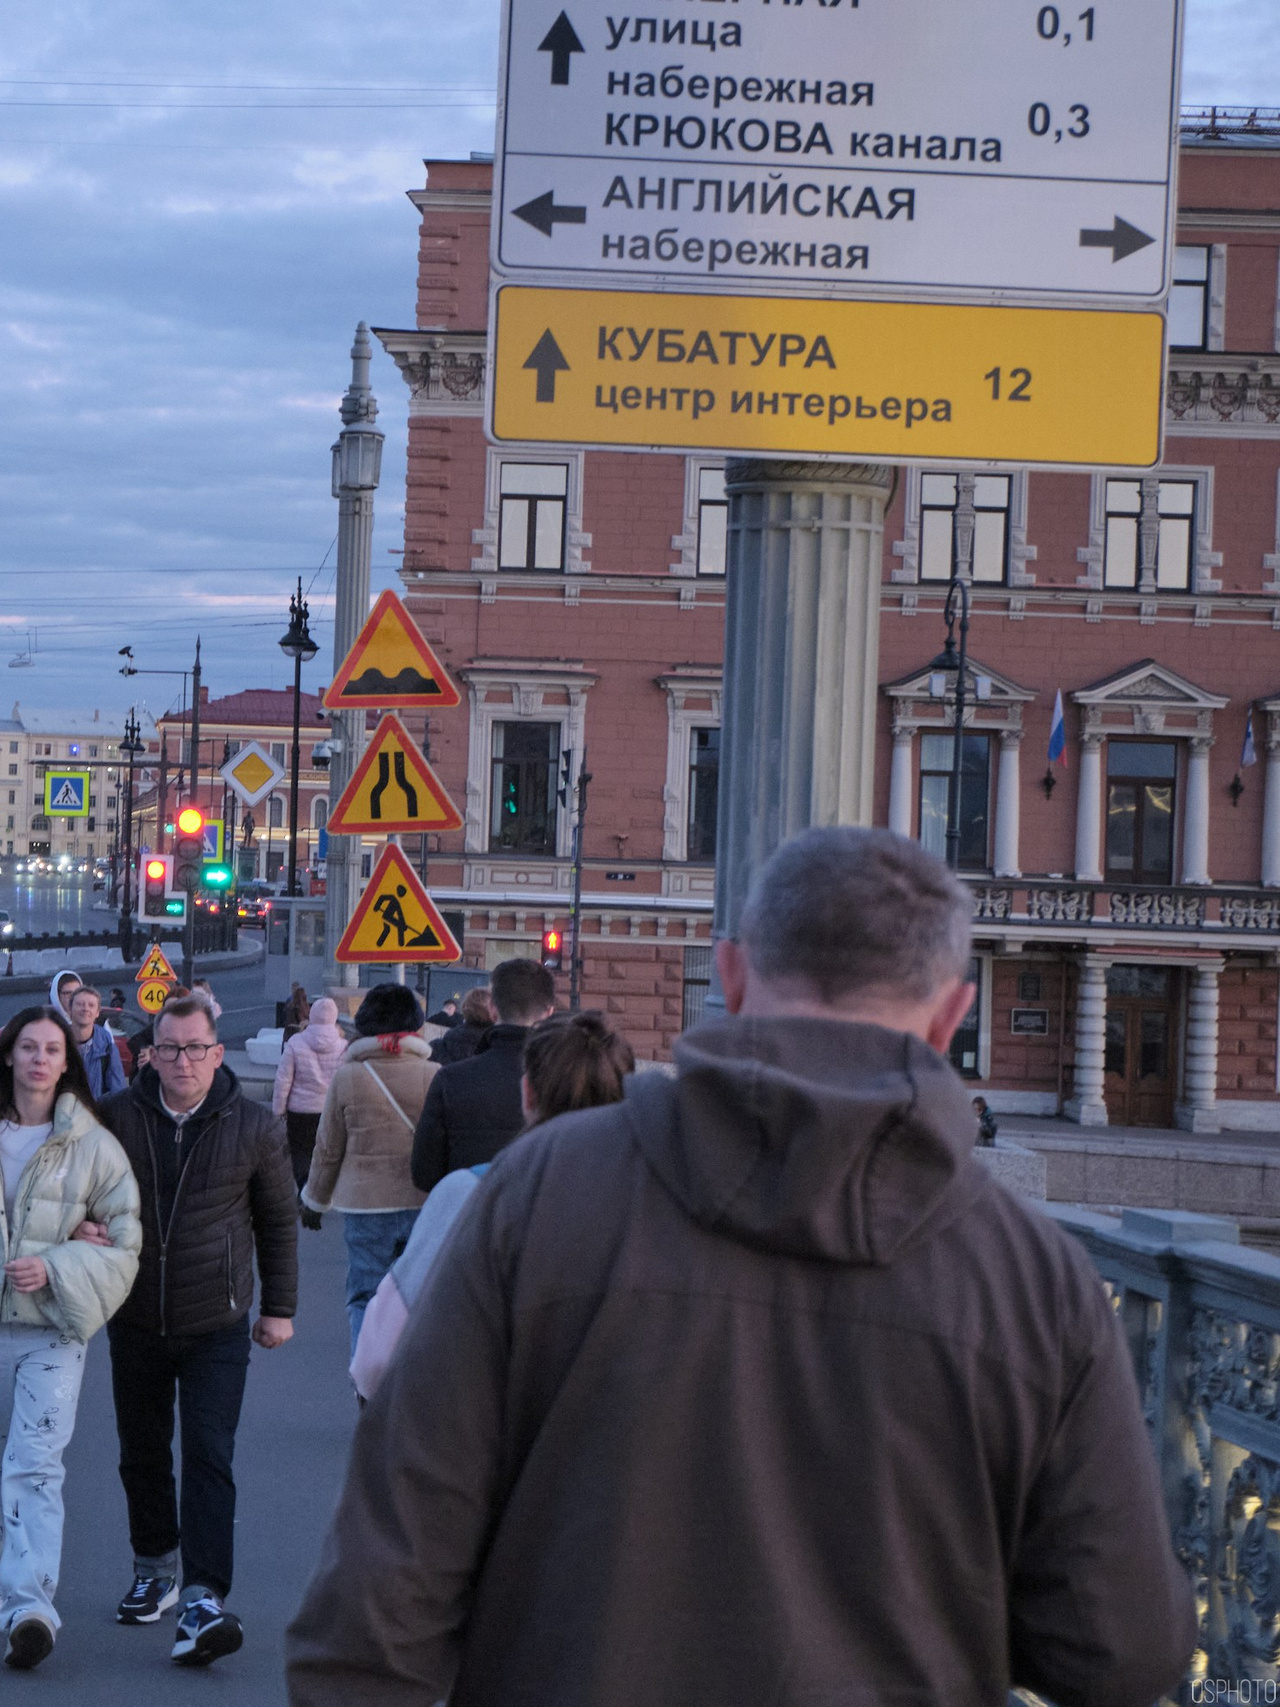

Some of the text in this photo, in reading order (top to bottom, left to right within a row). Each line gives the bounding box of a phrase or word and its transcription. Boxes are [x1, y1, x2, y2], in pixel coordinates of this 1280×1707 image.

[605, 15, 742, 51] улица
[1036, 6, 1096, 46] 0,1
[606, 65, 875, 109] набережная
[604, 113, 1002, 162] КРЮКОВА канала
[1028, 103, 1091, 141] 0,3
[603, 172, 917, 222] АНГЛИЙСКАЯ
[600, 230, 870, 271] набережная
[597, 325, 837, 370] КУБАТУРА
[983, 366, 1033, 402] 12
[594, 384, 953, 428] центр интерьера
[144, 989, 166, 1003] 40
